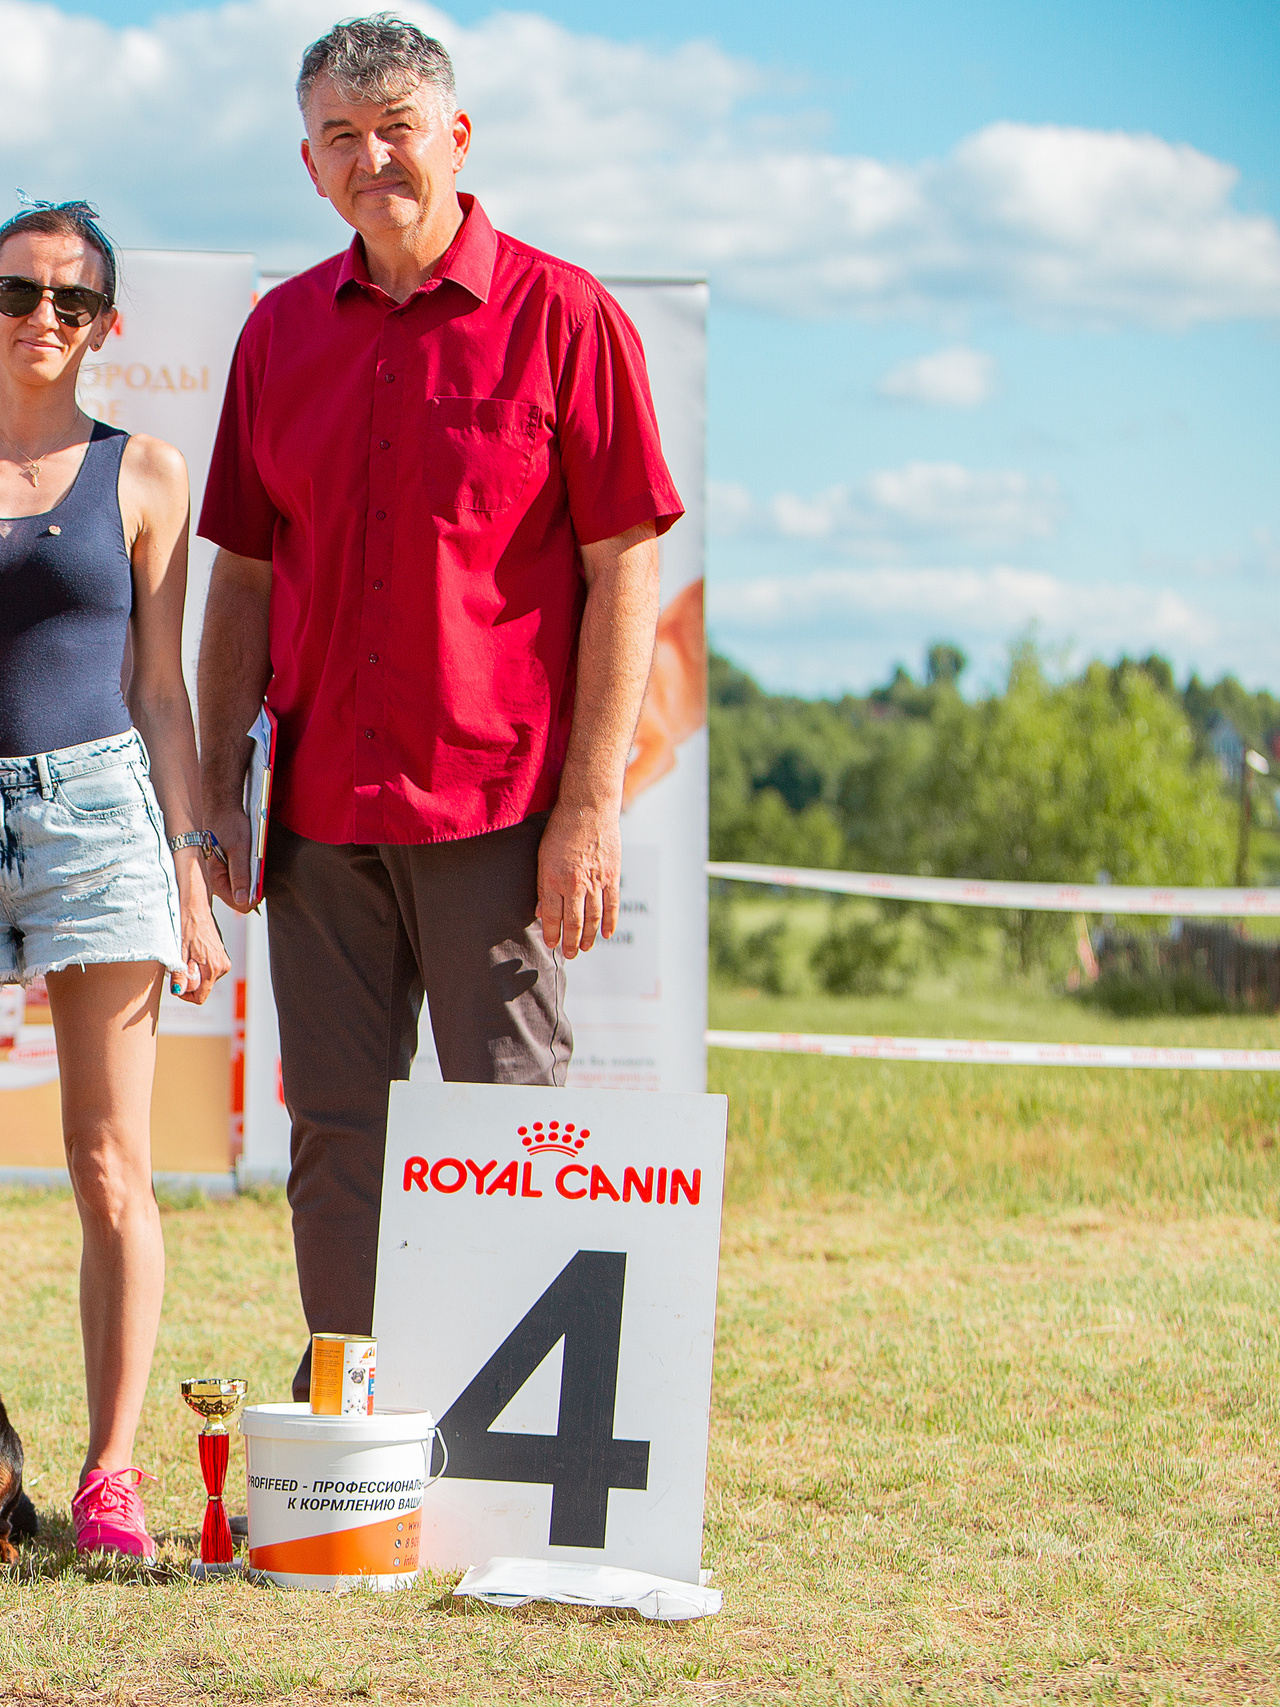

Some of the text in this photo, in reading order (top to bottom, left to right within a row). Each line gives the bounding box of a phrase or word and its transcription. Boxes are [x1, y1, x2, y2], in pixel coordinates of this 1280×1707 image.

[79, 361, 210, 395] ОРОДЫ
[402, 1155, 702, 1206] ROYAL CANIN
[430, 1249, 651, 1549] 4
[248, 1474, 298, 1492] PROFIFEED
[312, 1478, 424, 1494] ПРОФЕССИОНАЛЬ
[287, 1496, 423, 1512] К КОРМЛЕНИЮ ВАШИ
